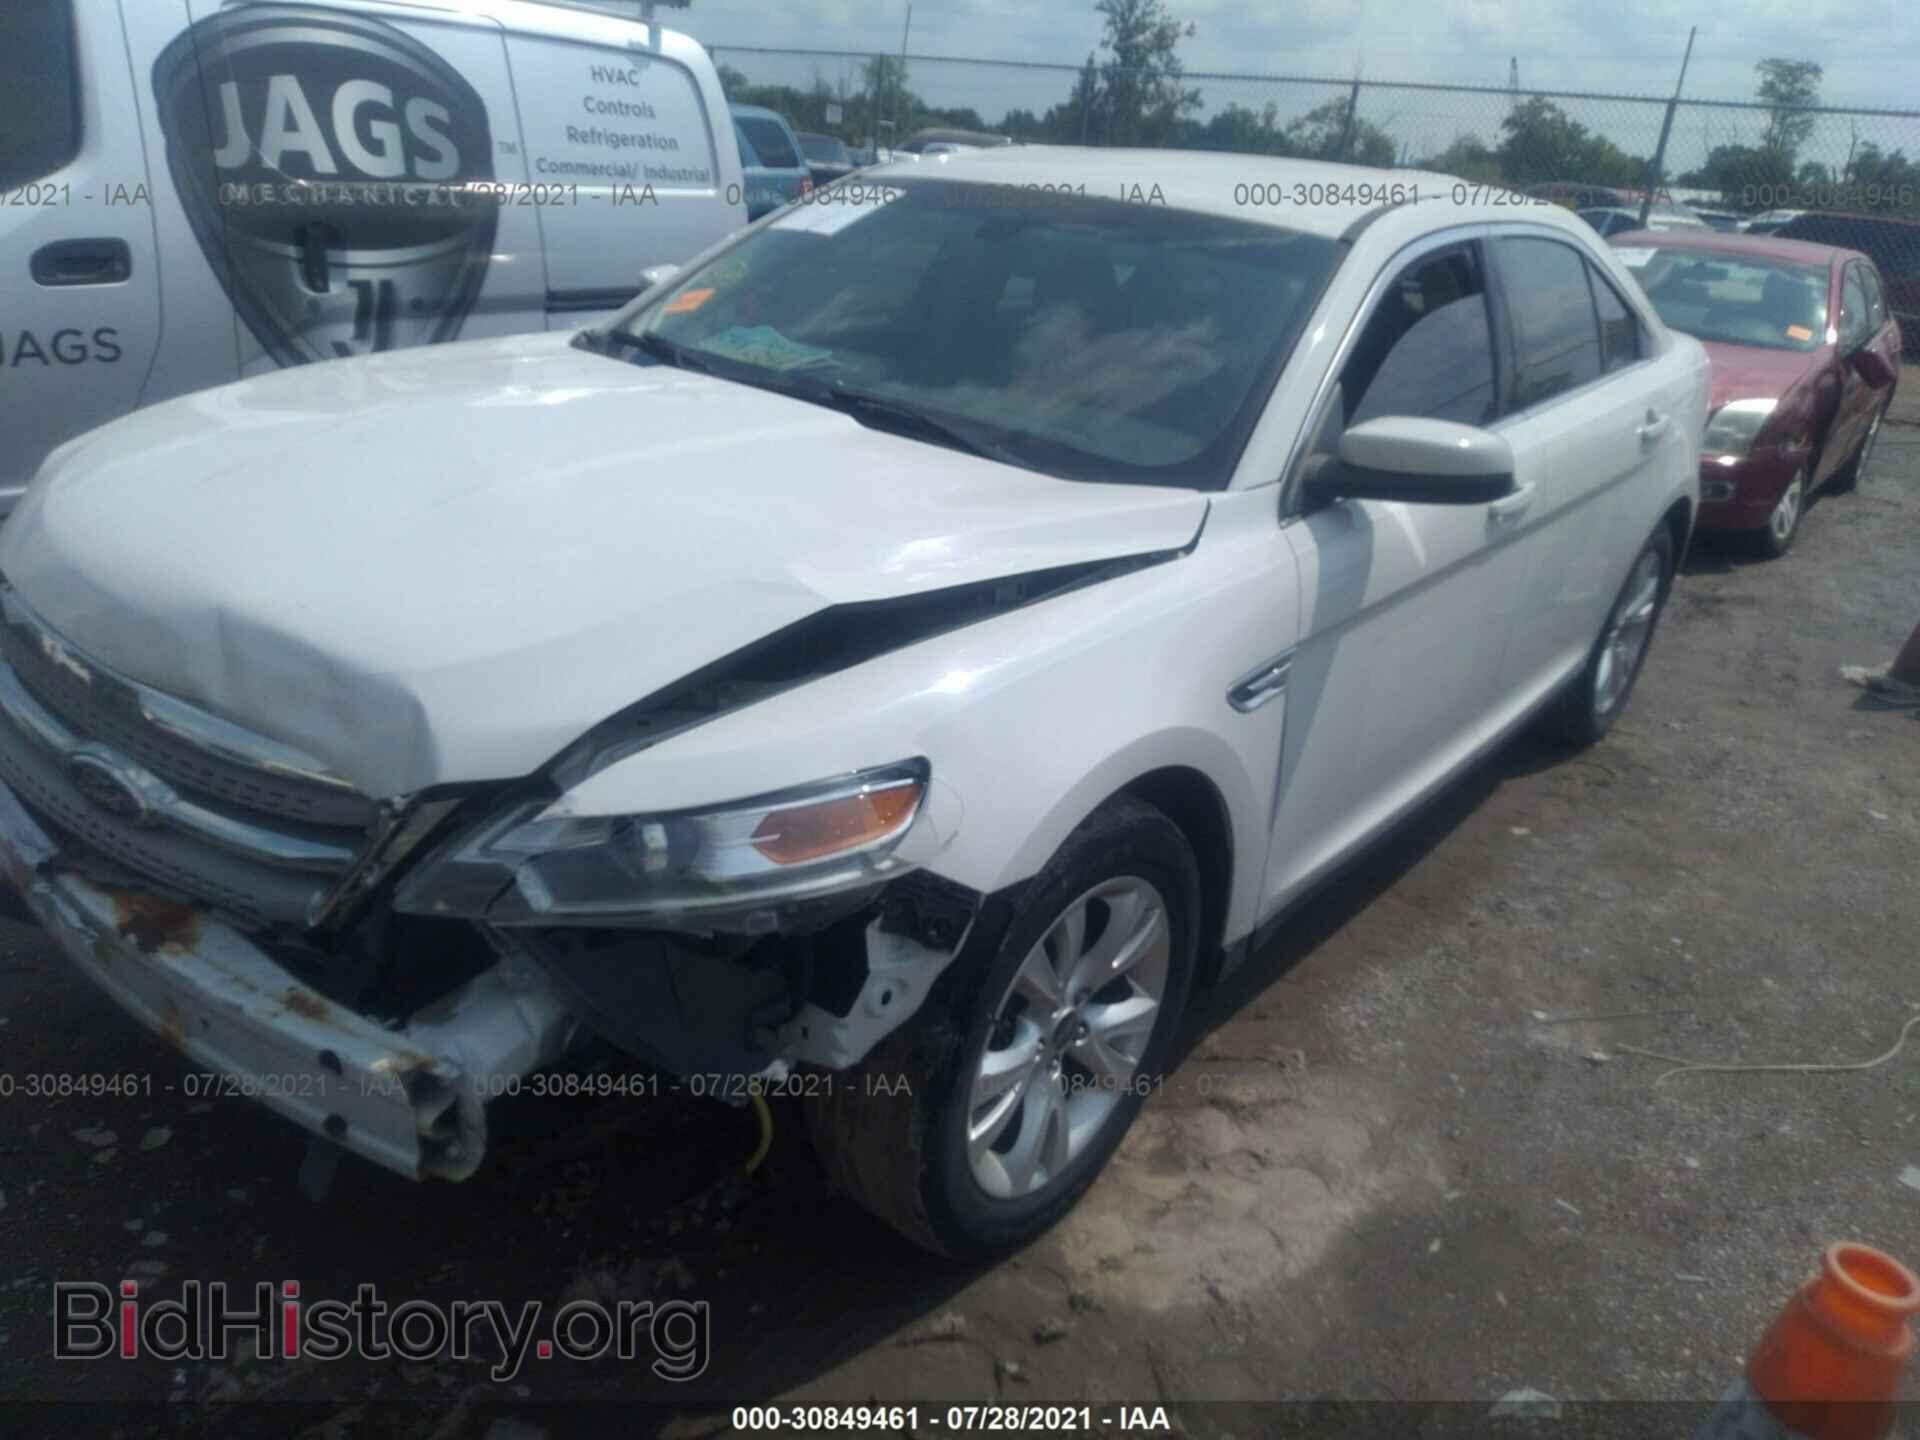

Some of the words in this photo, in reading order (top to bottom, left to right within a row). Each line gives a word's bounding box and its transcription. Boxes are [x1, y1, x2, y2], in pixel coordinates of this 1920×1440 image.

[591, 65, 640, 87] HVAC
[583, 96, 656, 119] Controls
[213, 74, 460, 180] JAGS
[566, 125, 679, 152] Refrigeration
[644, 163, 710, 183] Industrial
